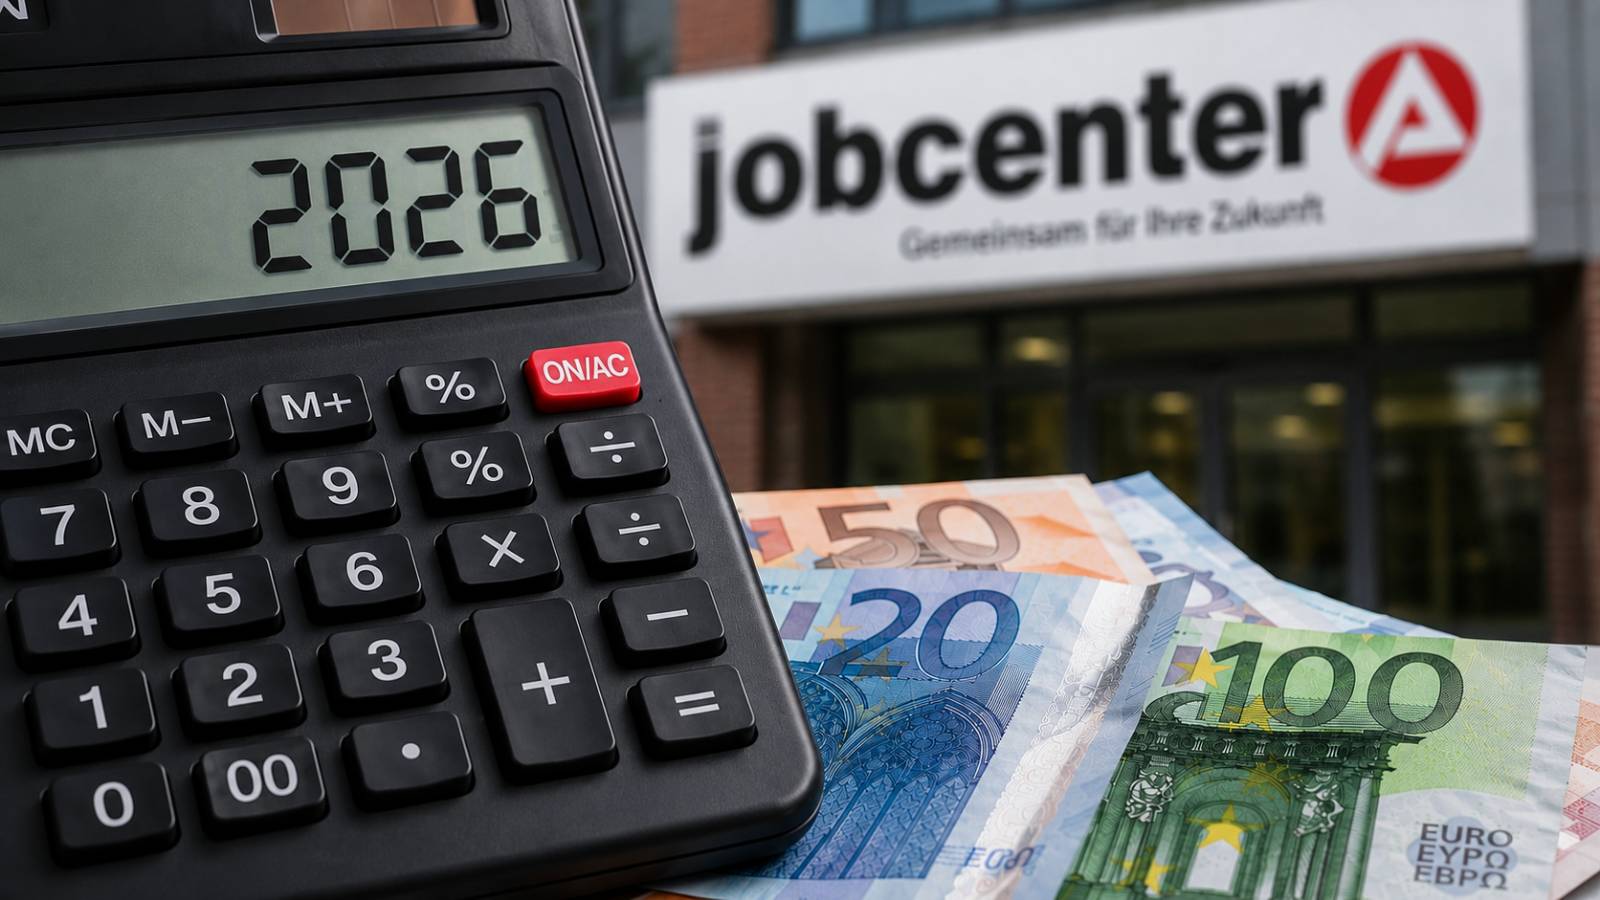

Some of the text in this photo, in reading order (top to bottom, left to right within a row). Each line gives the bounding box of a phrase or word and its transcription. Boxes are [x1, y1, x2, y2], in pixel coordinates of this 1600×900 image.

[685, 70, 1325, 257] jobcenter
[251, 139, 541, 274] 2026
[900, 193, 1325, 260] Gemeinsam für Ihre Zukunft
[543, 353, 630, 385] ON/AC
[280, 391, 352, 421] M+
[6, 423, 76, 456] MC
[182, 485, 220, 525] 8
[322, 466, 359, 505] 9
[39, 504, 76, 546] 7
[817, 498, 1020, 569] 50
[346, 551, 384, 591] 6
[58, 594, 98, 636] 4
[205, 572, 241, 615] 5
[816, 588, 1021, 682] 20
[367, 639, 407, 681] 3
[222, 662, 264, 707] 2
[1210, 640, 1464, 735] 100
[79, 685, 108, 729] 1
[226, 754, 298, 802] 00
[93, 781, 134, 827] 0
[1420, 823, 1513, 848] EURO
